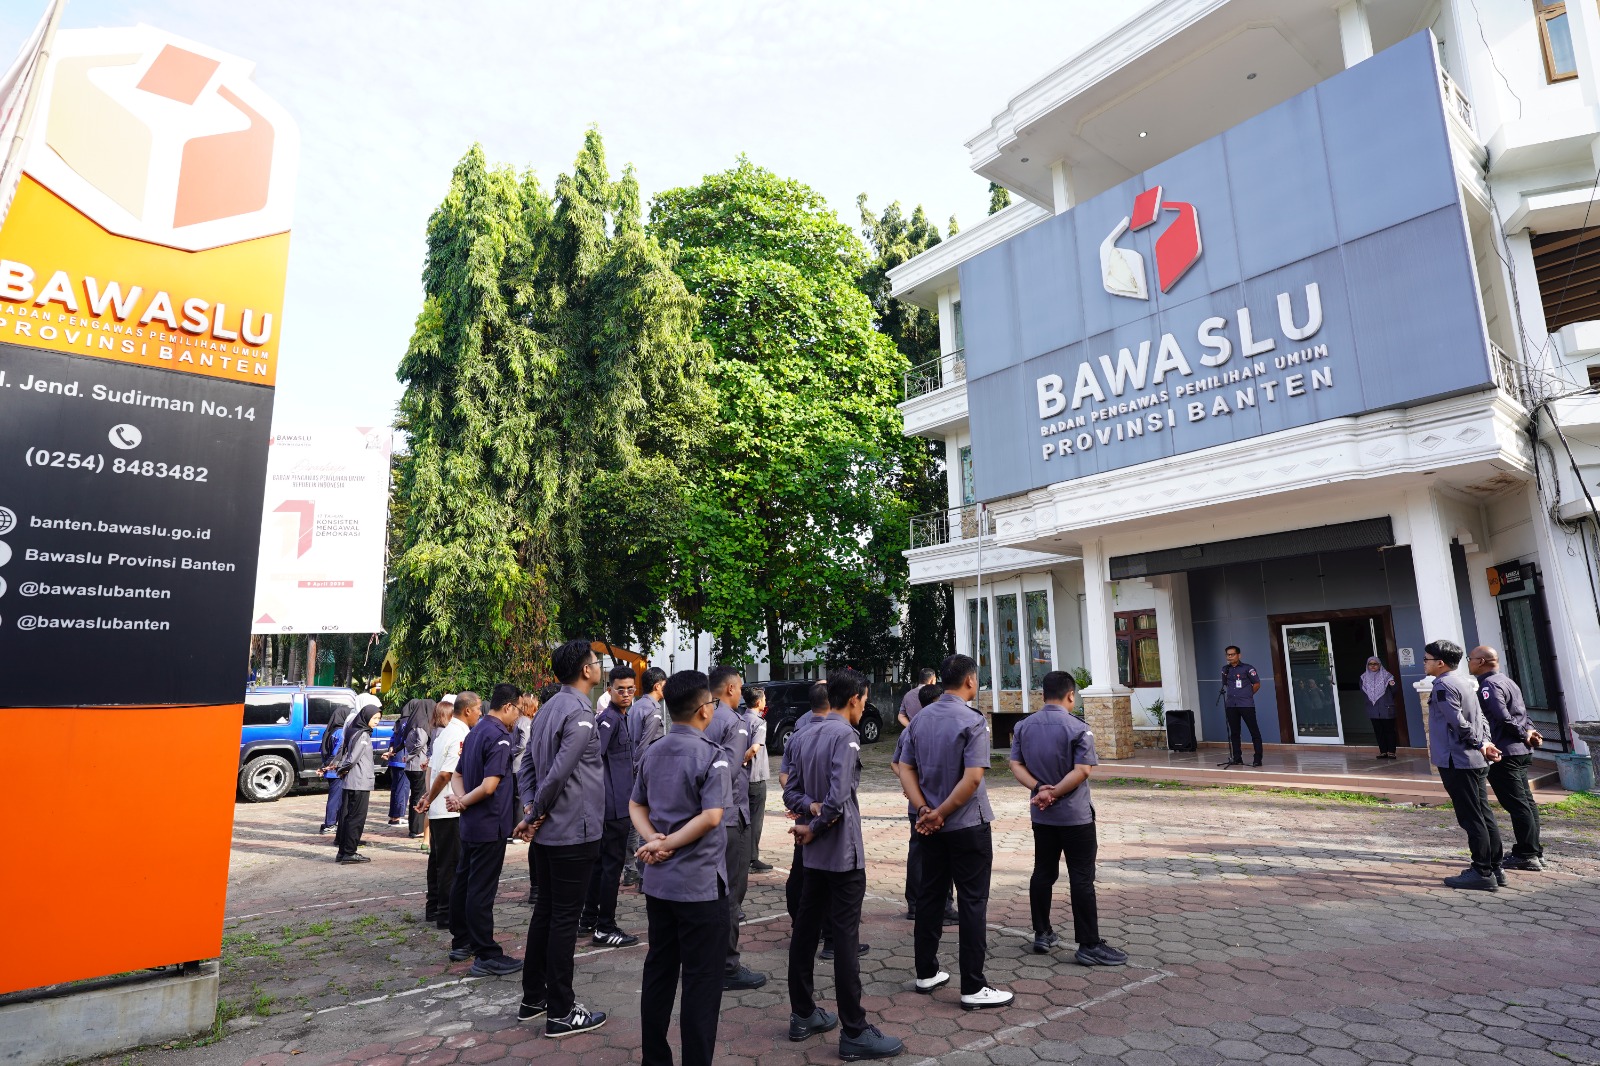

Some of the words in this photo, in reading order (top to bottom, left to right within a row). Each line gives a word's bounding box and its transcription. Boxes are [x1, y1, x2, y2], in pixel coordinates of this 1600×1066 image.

[0, 259, 273, 346] BAWASLU
[0, 303, 51, 321] ADAN
[58, 314, 143, 337] PENGAWAS
[150, 331, 227, 353] PEMILIHAN
[232, 346, 269, 360] UMUM
[1036, 282, 1323, 419] BAWASLU
[159, 345, 267, 376] BANTEN
[19, 374, 84, 398] Jend.
[92, 384, 195, 413] Sudirman
[201, 400, 256, 421] No.14
[1040, 415, 1086, 437] BADAN
[1091, 390, 1169, 423] PENGAWAS
[1176, 361, 1266, 398] PEMILIHAN
[1275, 343, 1329, 370] UMUM
[1042, 408, 1176, 461] PROVINSI
[1188, 366, 1333, 422] BANTEN
[25, 446, 105, 473] (0254)
[112, 458, 208, 482] 8483482
[30, 515, 211, 540] banten.bawaslu.go.id
[25, 548, 102, 565] Bawaslu
[107, 553, 176, 569] Provinsi
[181, 557, 236, 572] Banten
[19, 581, 171, 599] @bawaslubanten
[17, 614, 170, 631] @bawaslubanten
